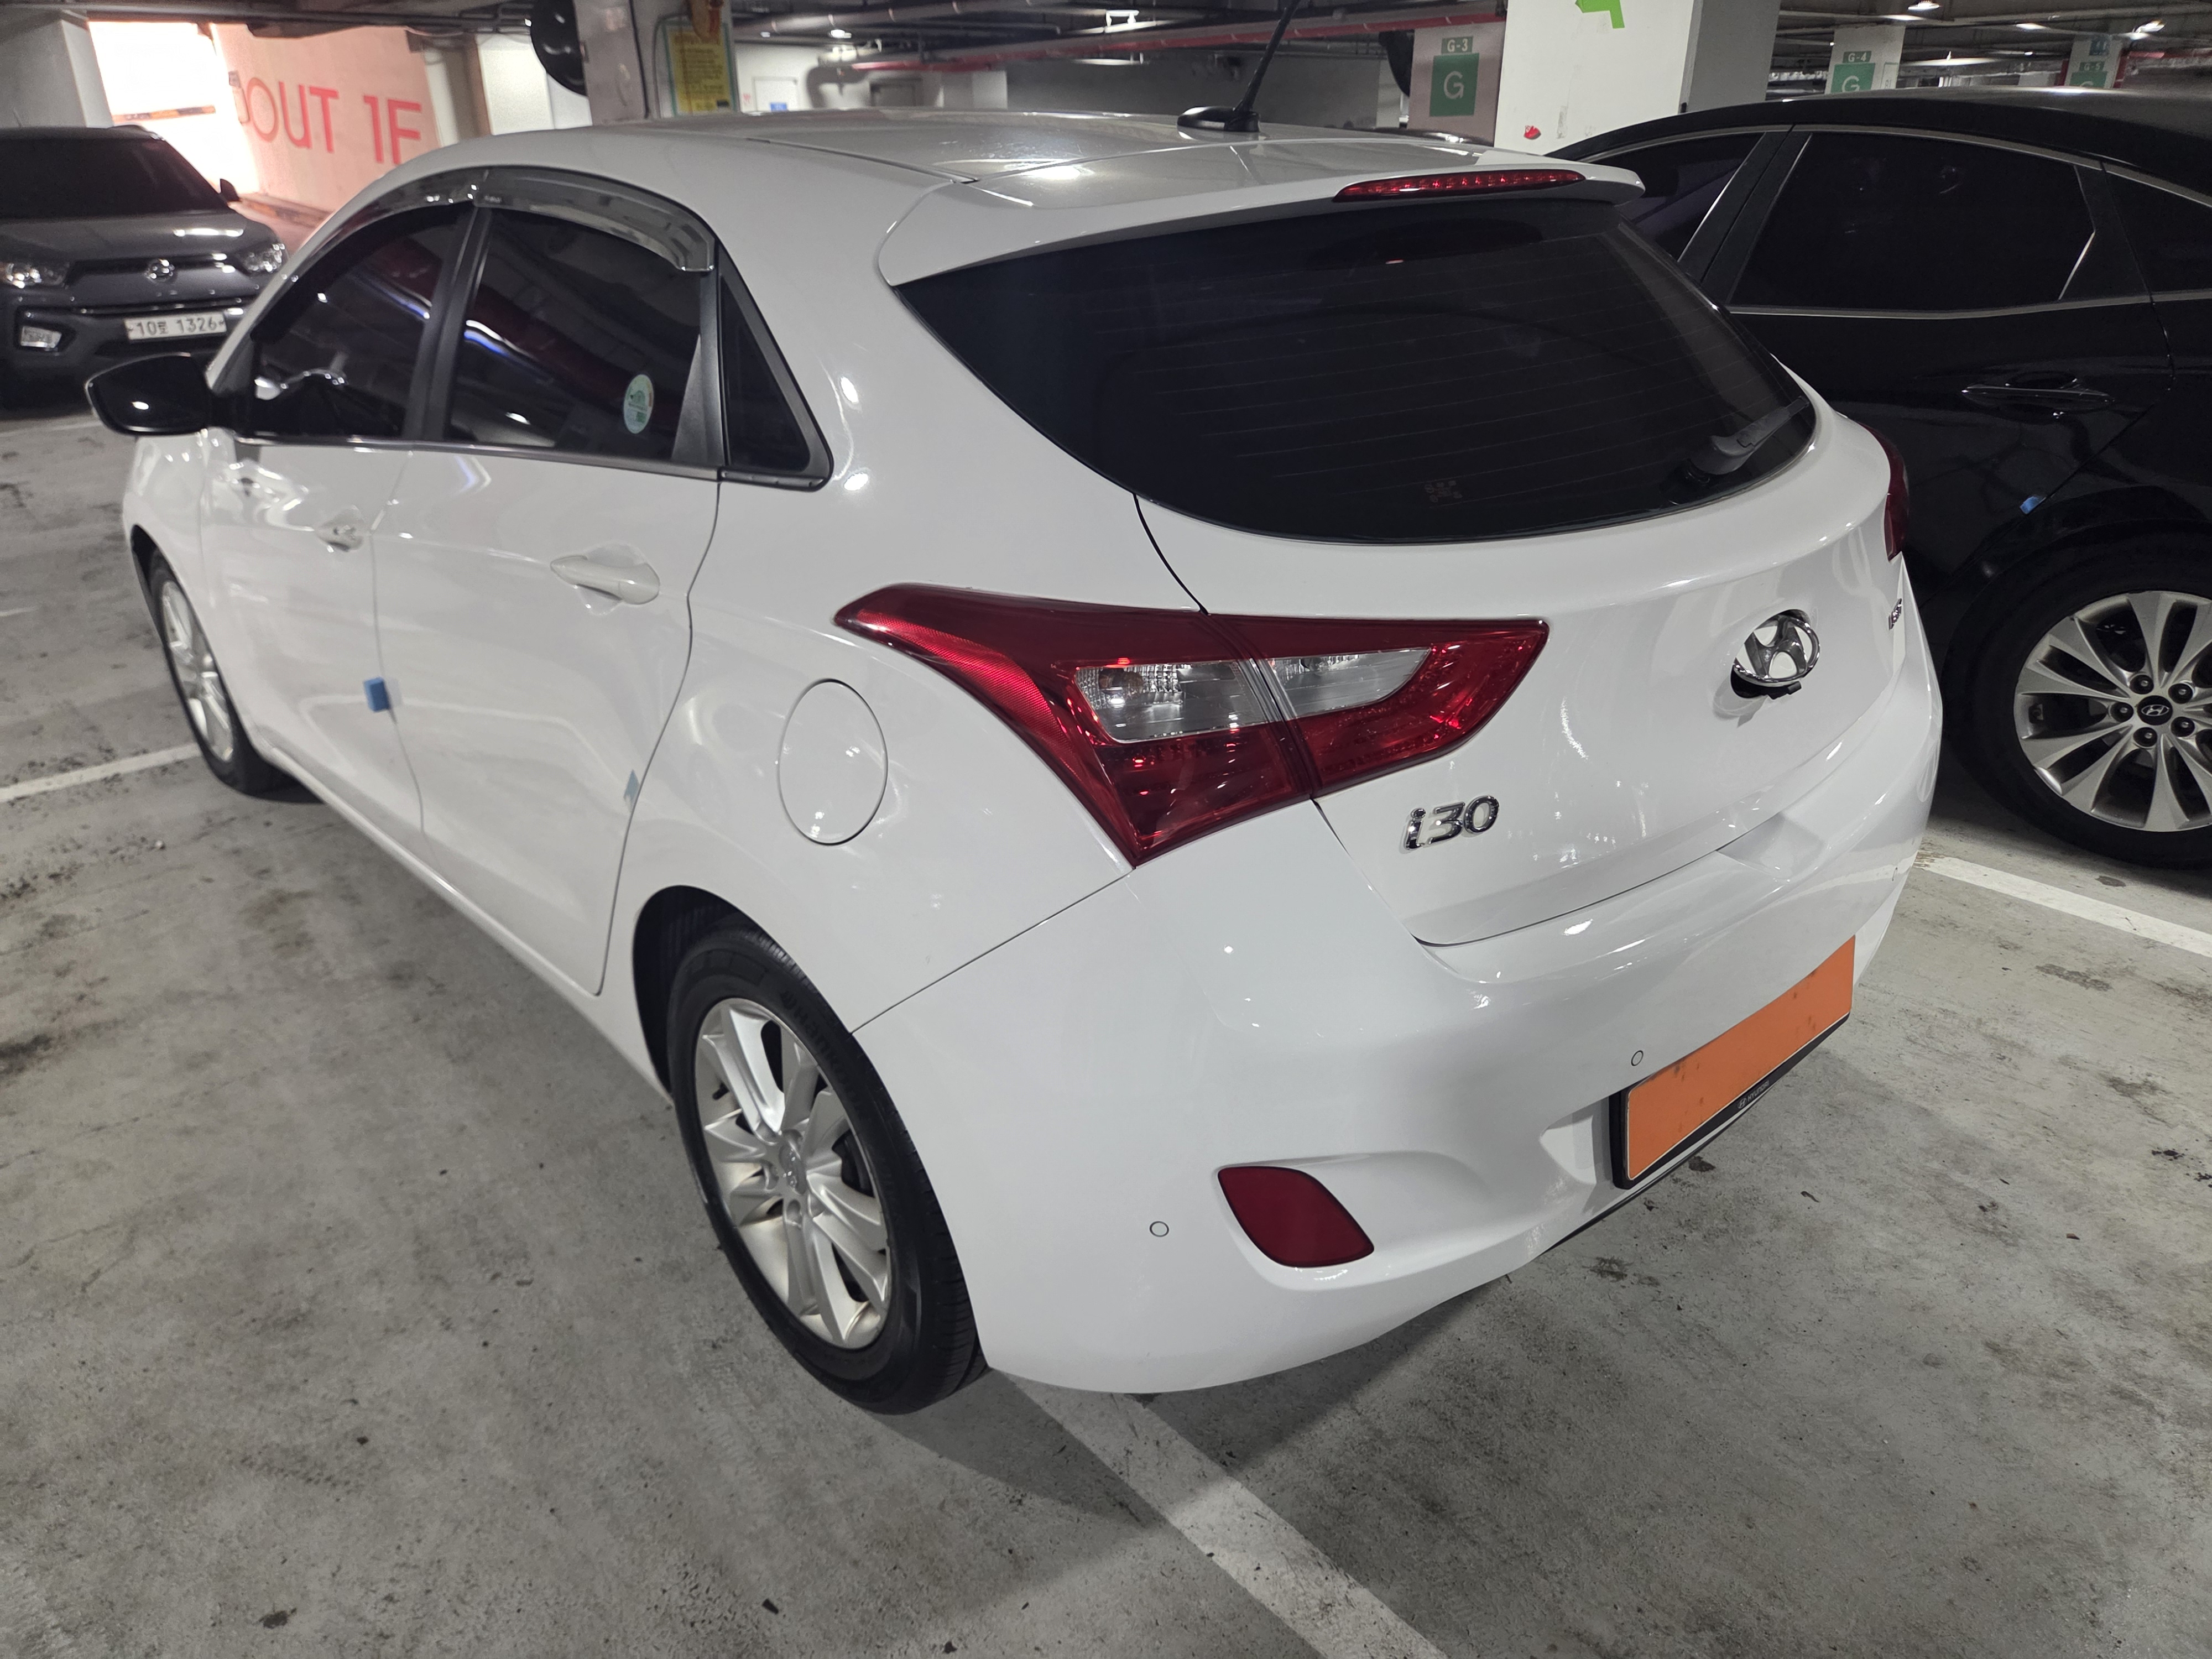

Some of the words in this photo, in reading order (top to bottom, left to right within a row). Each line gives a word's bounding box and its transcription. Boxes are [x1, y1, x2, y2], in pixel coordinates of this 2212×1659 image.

[1447, 38, 1468, 52] G-3
[1848, 53, 1866, 62] G-4
[1444, 71, 1464, 99] G
[1842, 75, 1860, 92] G
[247, 77, 339, 154] OUT
[363, 95, 421, 165] 1F
[176, 317, 217, 333] 1326
[1405, 795, 1499, 849] i30
[1747, 1080, 1770, 1102] HYUNDAI
